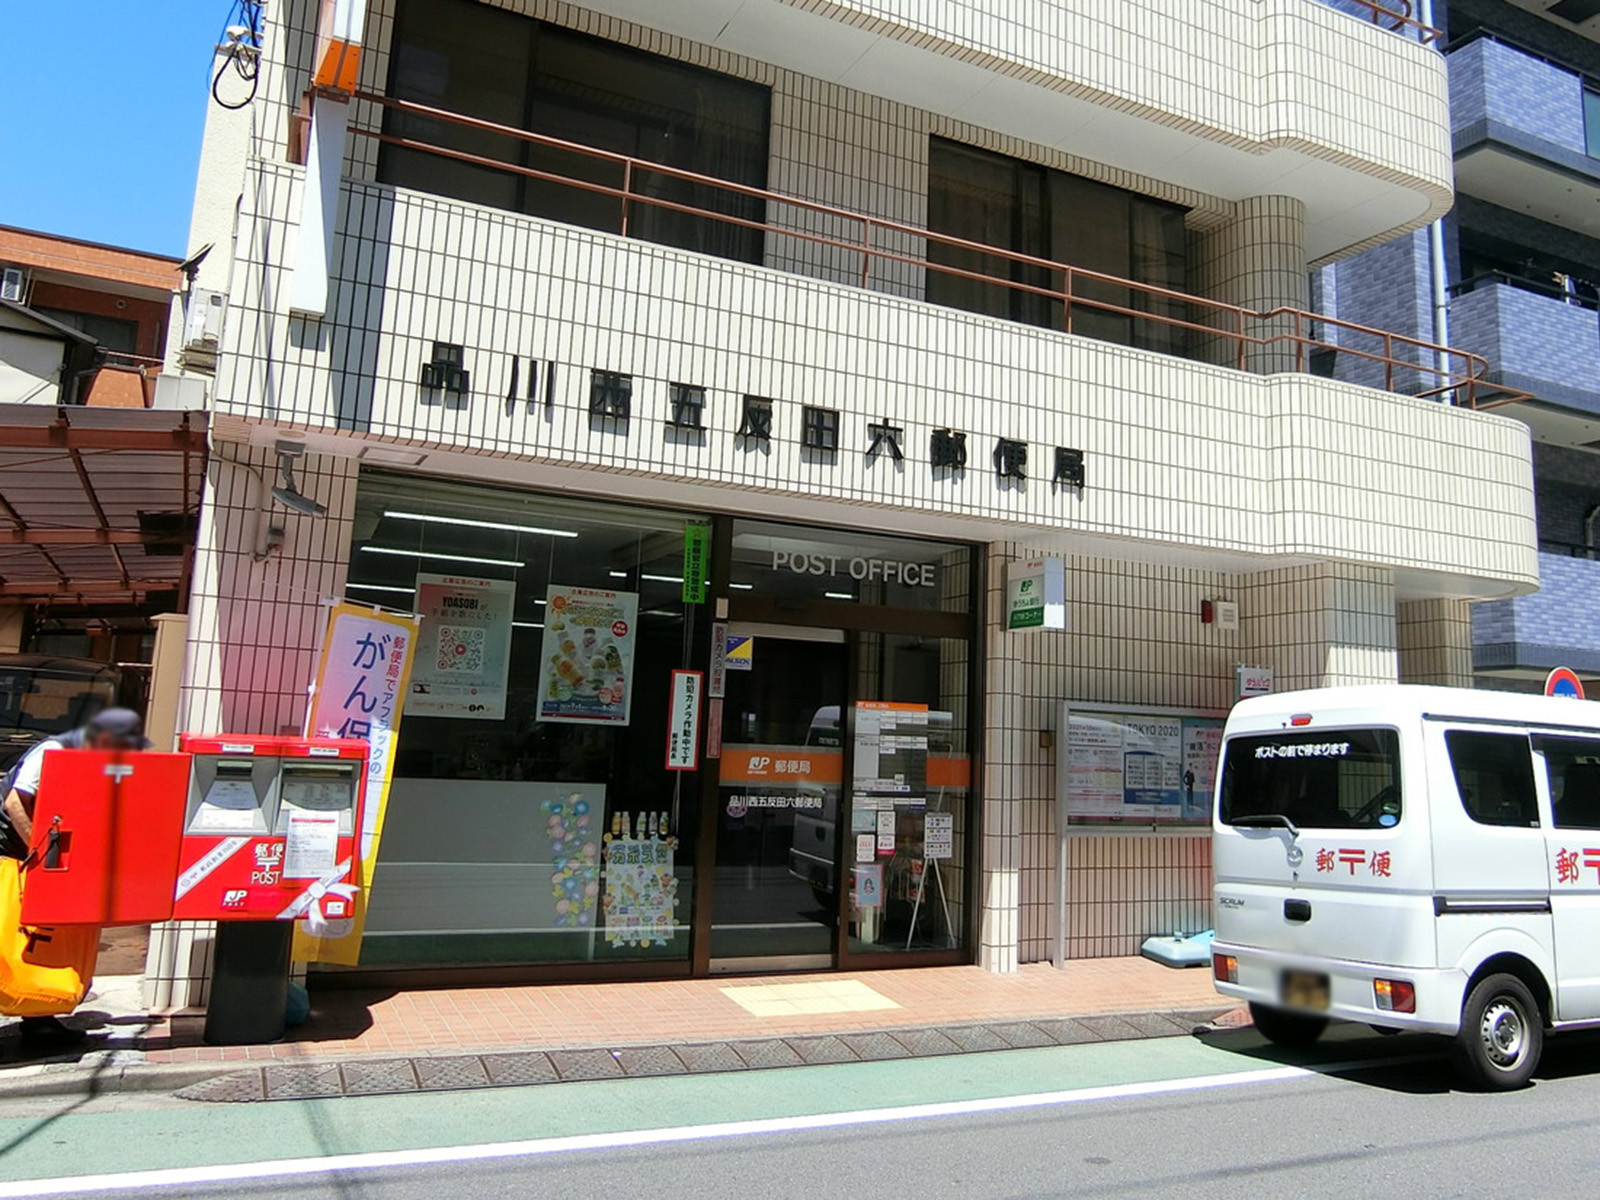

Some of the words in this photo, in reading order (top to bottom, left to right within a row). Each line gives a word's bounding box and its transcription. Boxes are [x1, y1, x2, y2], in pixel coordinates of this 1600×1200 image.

[420, 341, 1085, 488] 品川西五反田六郵便局
[772, 551, 841, 576] POST
[850, 557, 935, 587] OFFICE
[1127, 723, 1156, 736] TOKYO
[1158, 725, 1179, 737] 2020
[775, 760, 811, 774] 郵便局
[251, 871, 281, 885] POST
